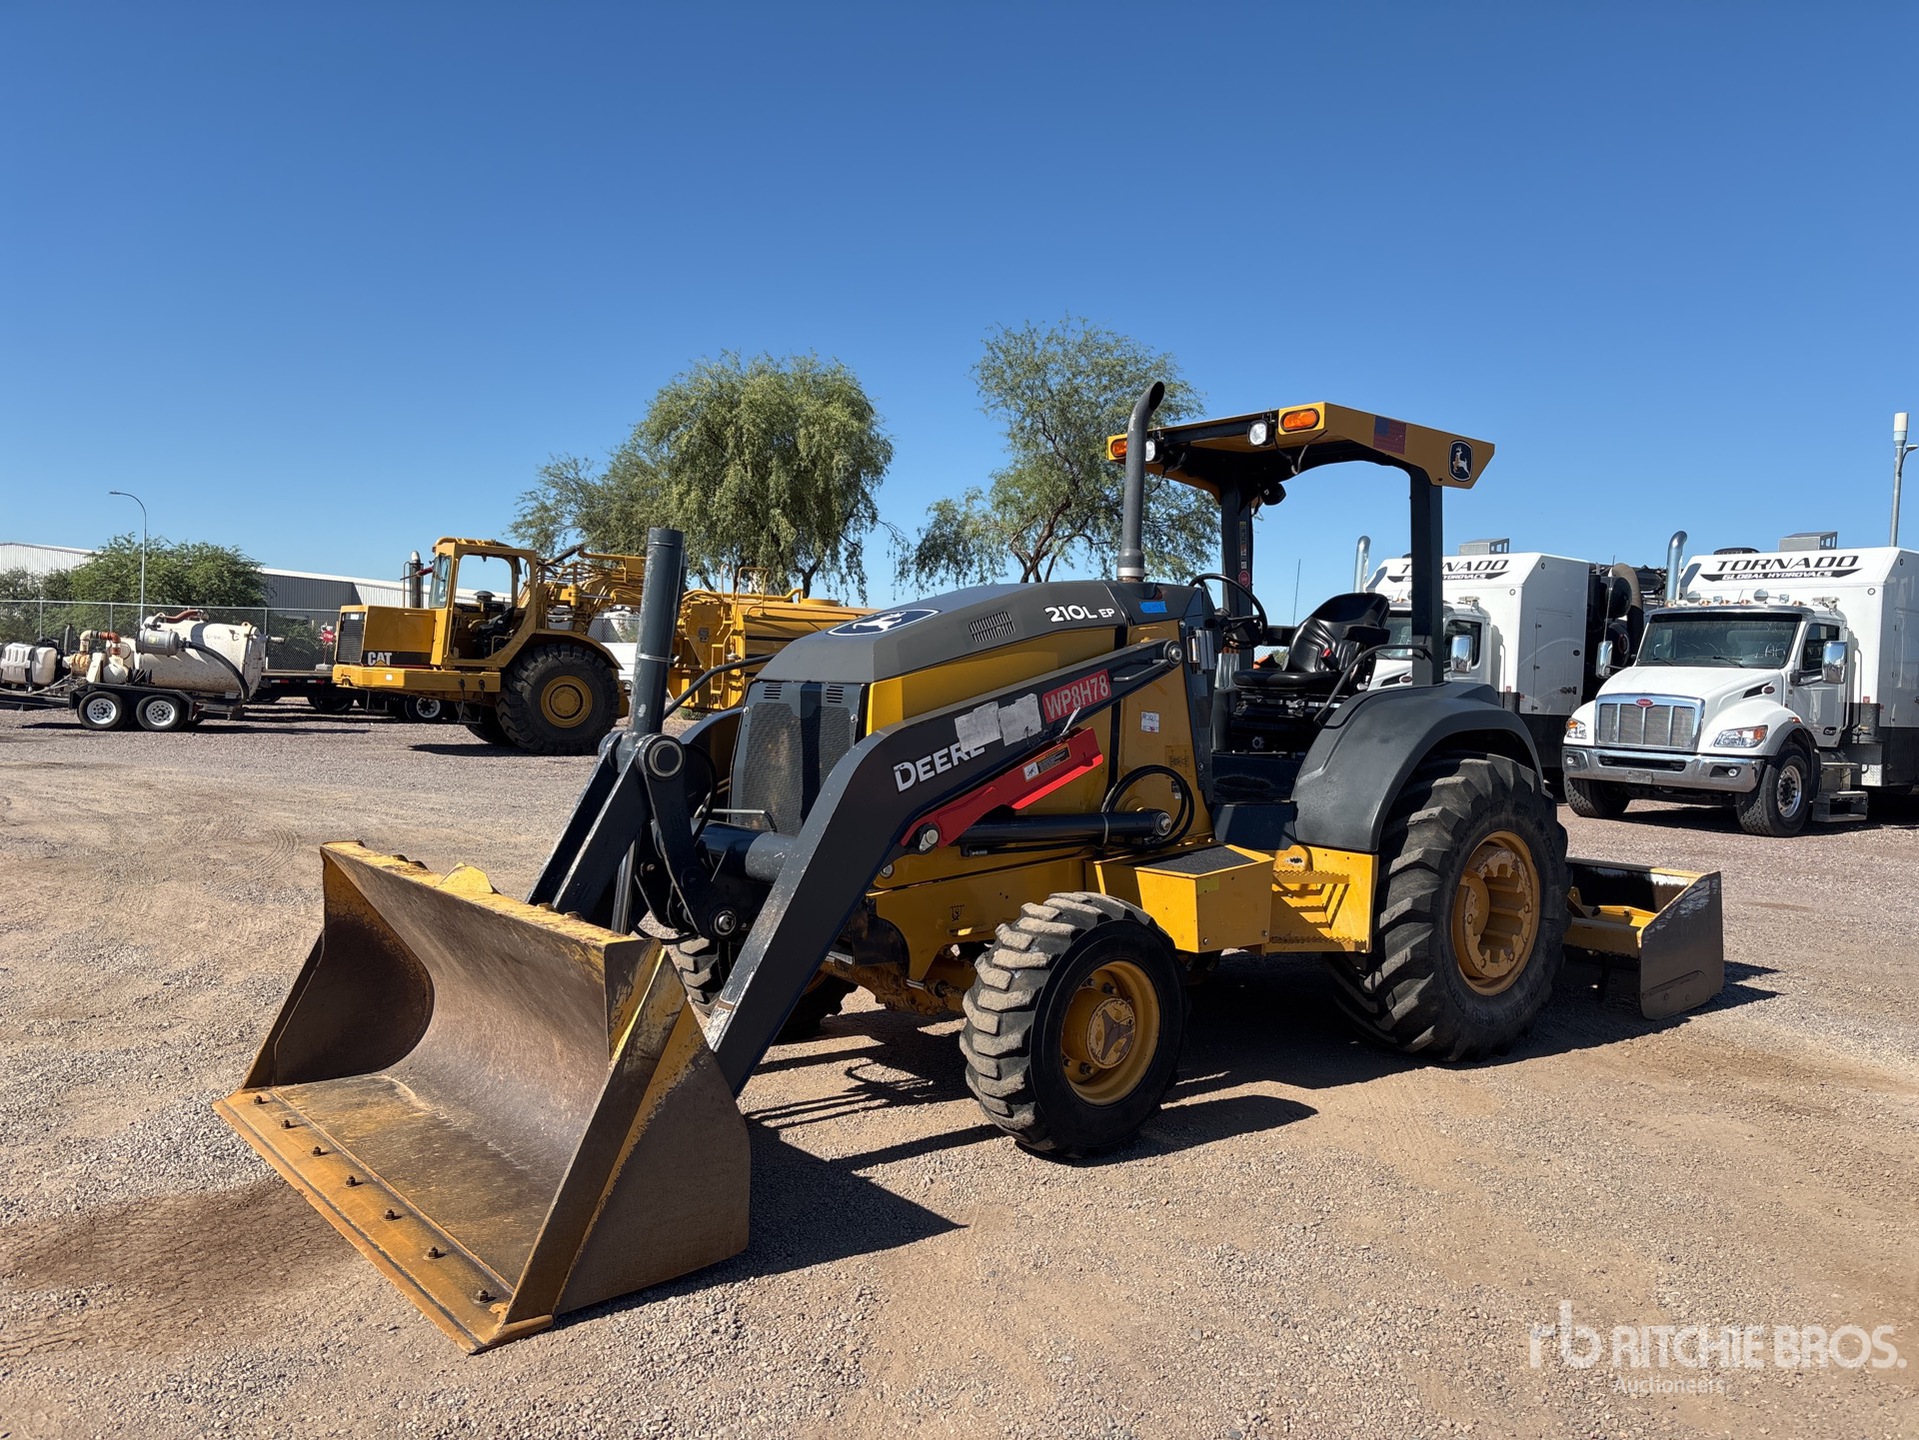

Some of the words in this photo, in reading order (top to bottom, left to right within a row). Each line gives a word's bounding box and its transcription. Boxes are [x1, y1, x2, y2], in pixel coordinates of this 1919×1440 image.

[1401, 560, 1510, 574] TNADO
[1717, 555, 1860, 572] TORNADO
[1721, 572, 1765, 581] GLOBAL
[1767, 570, 1833, 579] HYDROVACS
[1045, 604, 1098, 622] 210L
[1098, 608, 1115, 618] EP
[367, 651, 393, 667] CAT
[1045, 674, 1109, 720] WP8H78
